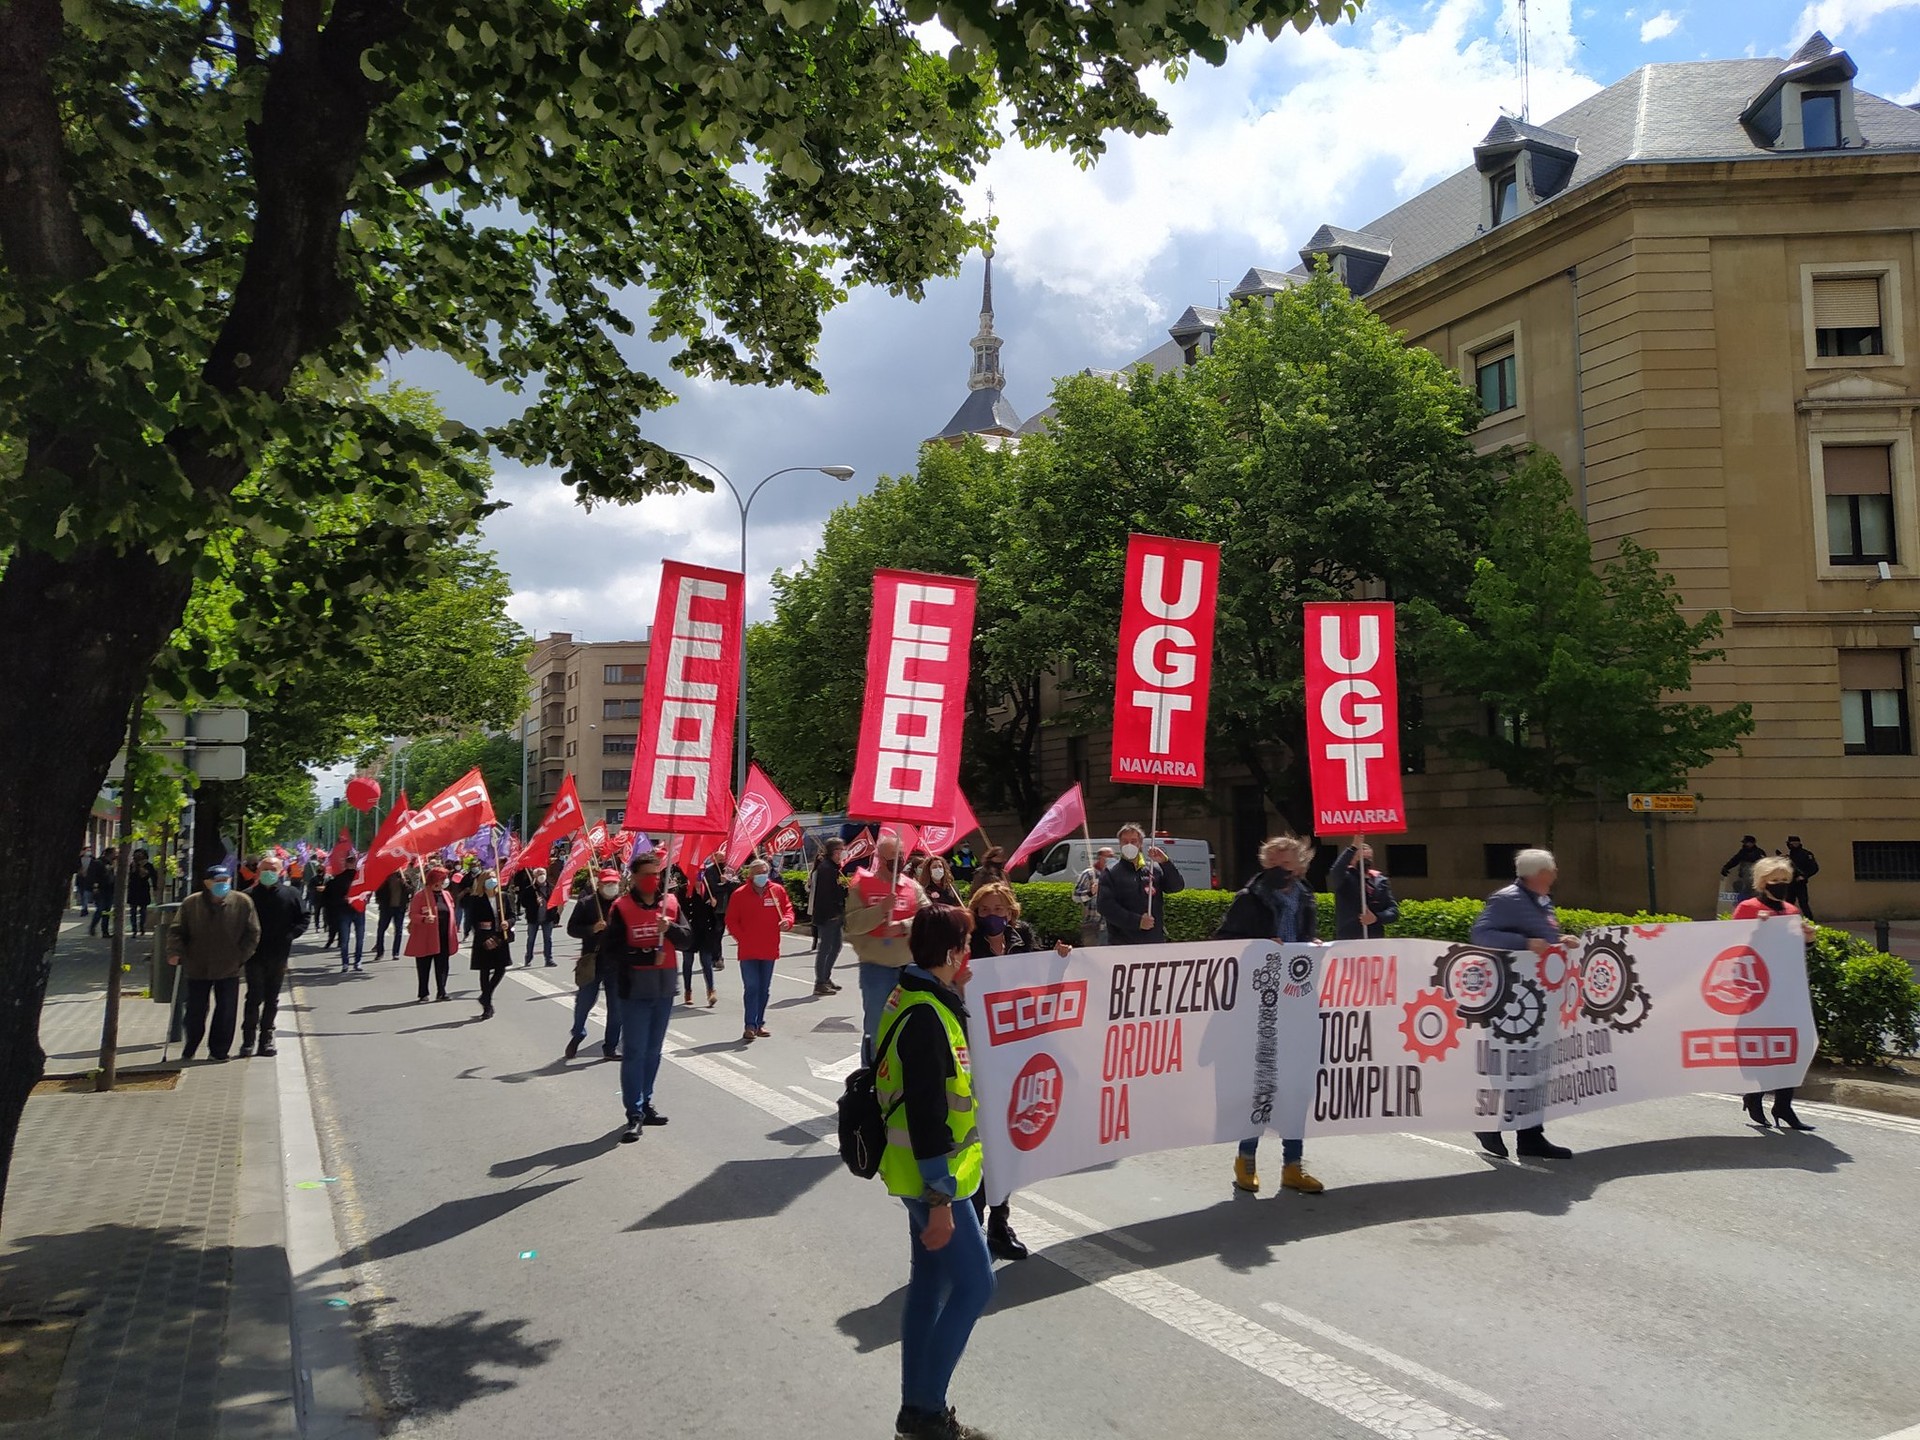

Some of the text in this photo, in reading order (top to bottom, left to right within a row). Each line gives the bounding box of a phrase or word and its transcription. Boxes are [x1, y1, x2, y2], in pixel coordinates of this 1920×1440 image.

[1132, 554, 1204, 755] UGT
[647, 576, 728, 817] CCOO
[873, 582, 956, 808] CCOO
[1320, 615, 1385, 802] UGT
[1119, 757, 1198, 777] NAVARRA
[1321, 809, 1399, 824] NAVARRA
[1109, 956, 1239, 1021] BETETZEKO
[1319, 955, 1397, 1008] AHORA
[990, 990, 1081, 1035] CCOO
[1319, 1010, 1373, 1065] TOCA
[1102, 1018, 1183, 1082] ORDUA
[1687, 1035, 1792, 1061] CCOO
[1100, 1083, 1130, 1145] DA
[1314, 1065, 1423, 1122] CUMPLIR
